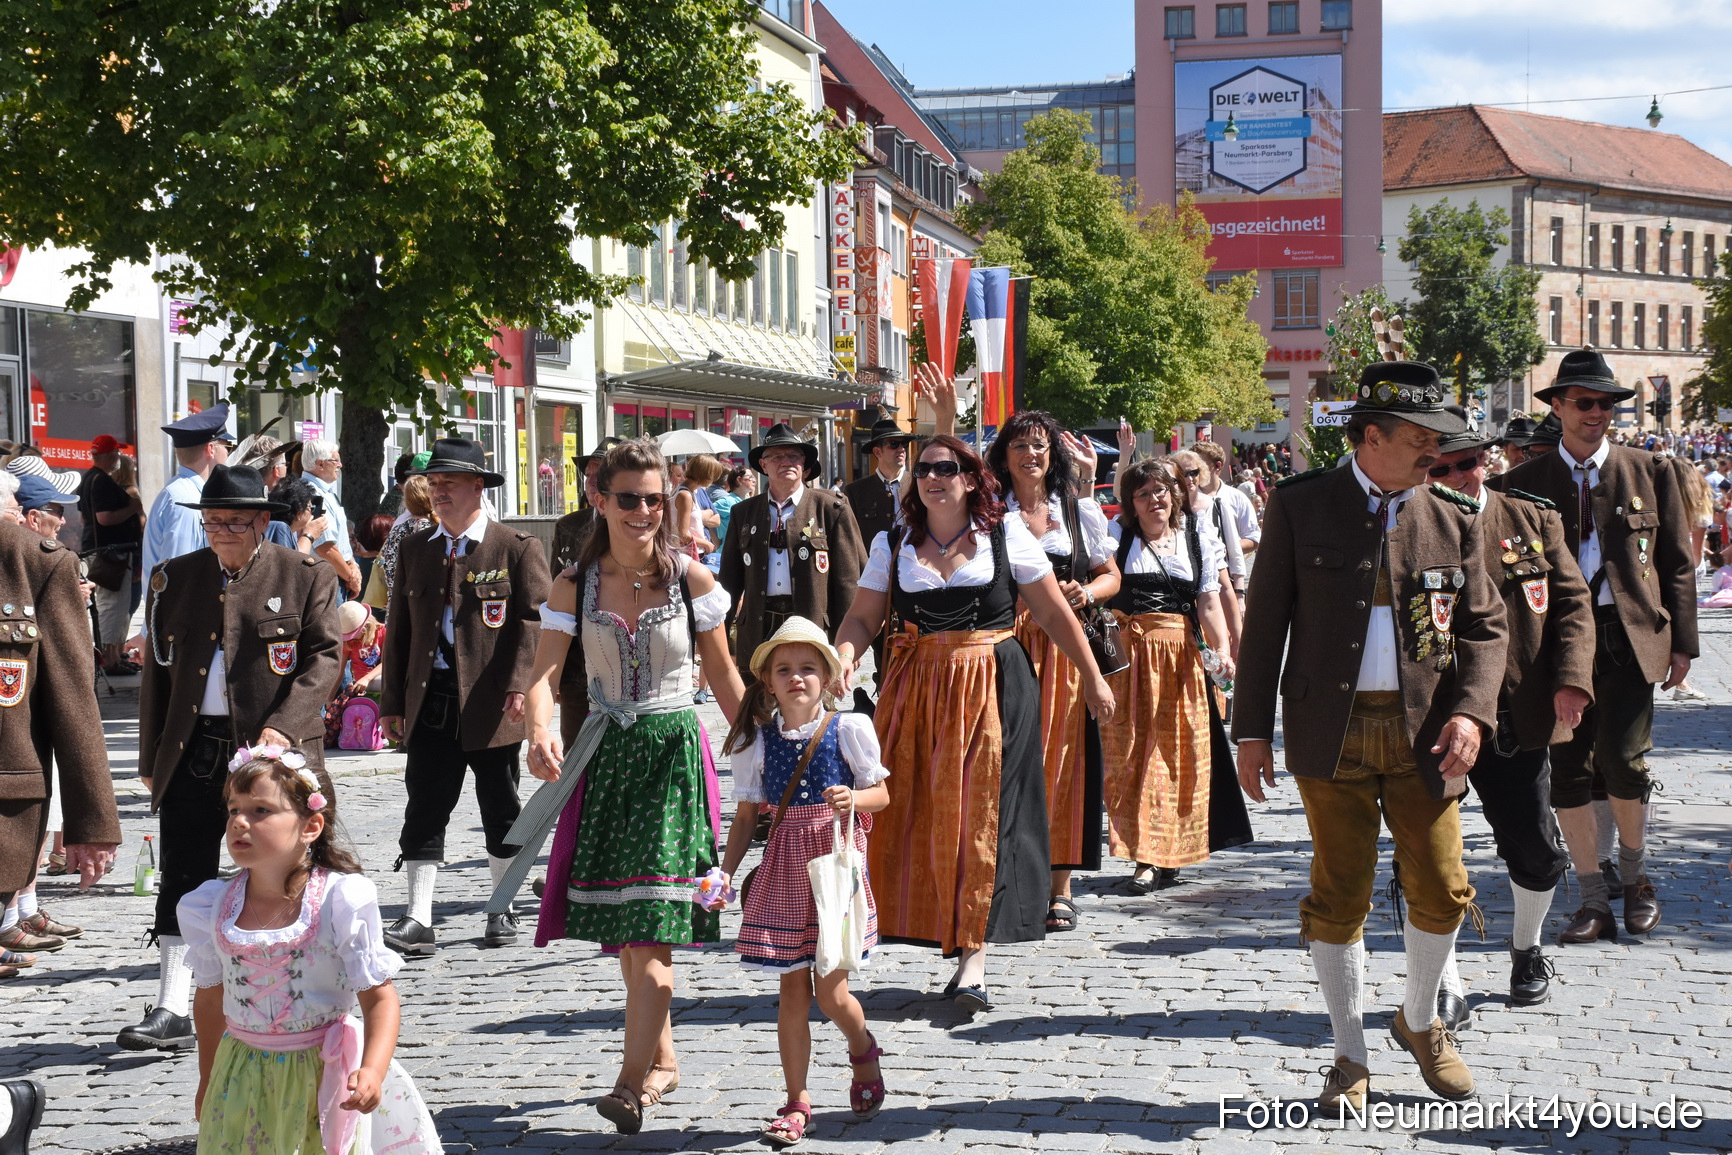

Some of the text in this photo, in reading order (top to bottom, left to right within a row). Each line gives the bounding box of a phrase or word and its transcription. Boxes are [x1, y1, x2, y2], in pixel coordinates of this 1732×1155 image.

[1216, 94, 1240, 106] DIE
[1249, 121, 1293, 129] BANKENTEST
[1214, 129, 1303, 139] Beng Baufinanzierung
[1240, 143, 1276, 151] Sparkasse
[1224, 149, 1293, 159] Neumarkt-Parsberg
[1207, 215, 1326, 238] usgezeichnet!
[835, 337, 854, 350] café
[1266, 346, 1323, 362] rkasse
[31, 403, 46, 426] LE
[1316, 416, 1338, 425] OGV
[42, 446, 56, 458] SALE
[57, 448, 71, 459] SALE
[72, 449, 86, 460] SALE
